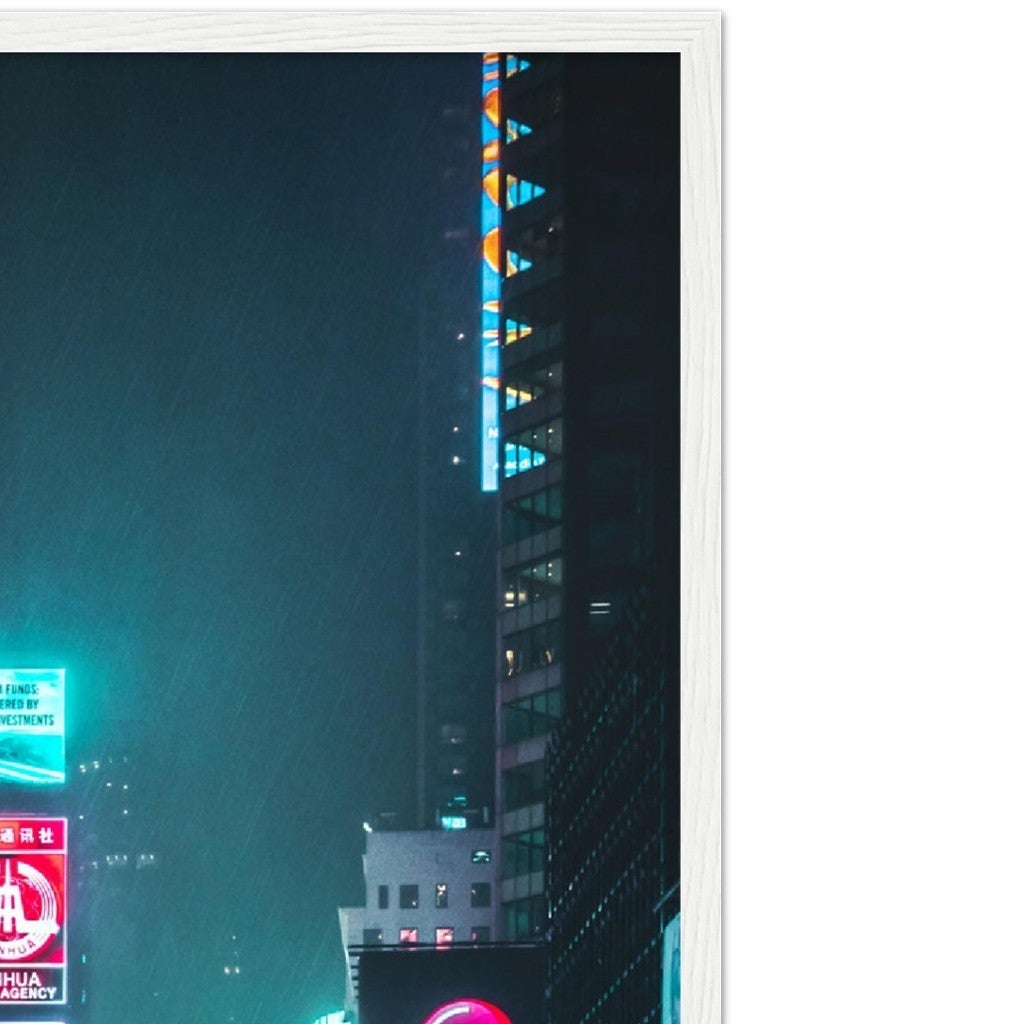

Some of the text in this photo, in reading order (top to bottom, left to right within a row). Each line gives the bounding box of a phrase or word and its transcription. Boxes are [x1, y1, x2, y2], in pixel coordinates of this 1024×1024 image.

[5, 684, 39, 695] FUNDS:
[26, 699, 39, 710] BY
[0, 987, 58, 1000] AGENCY
